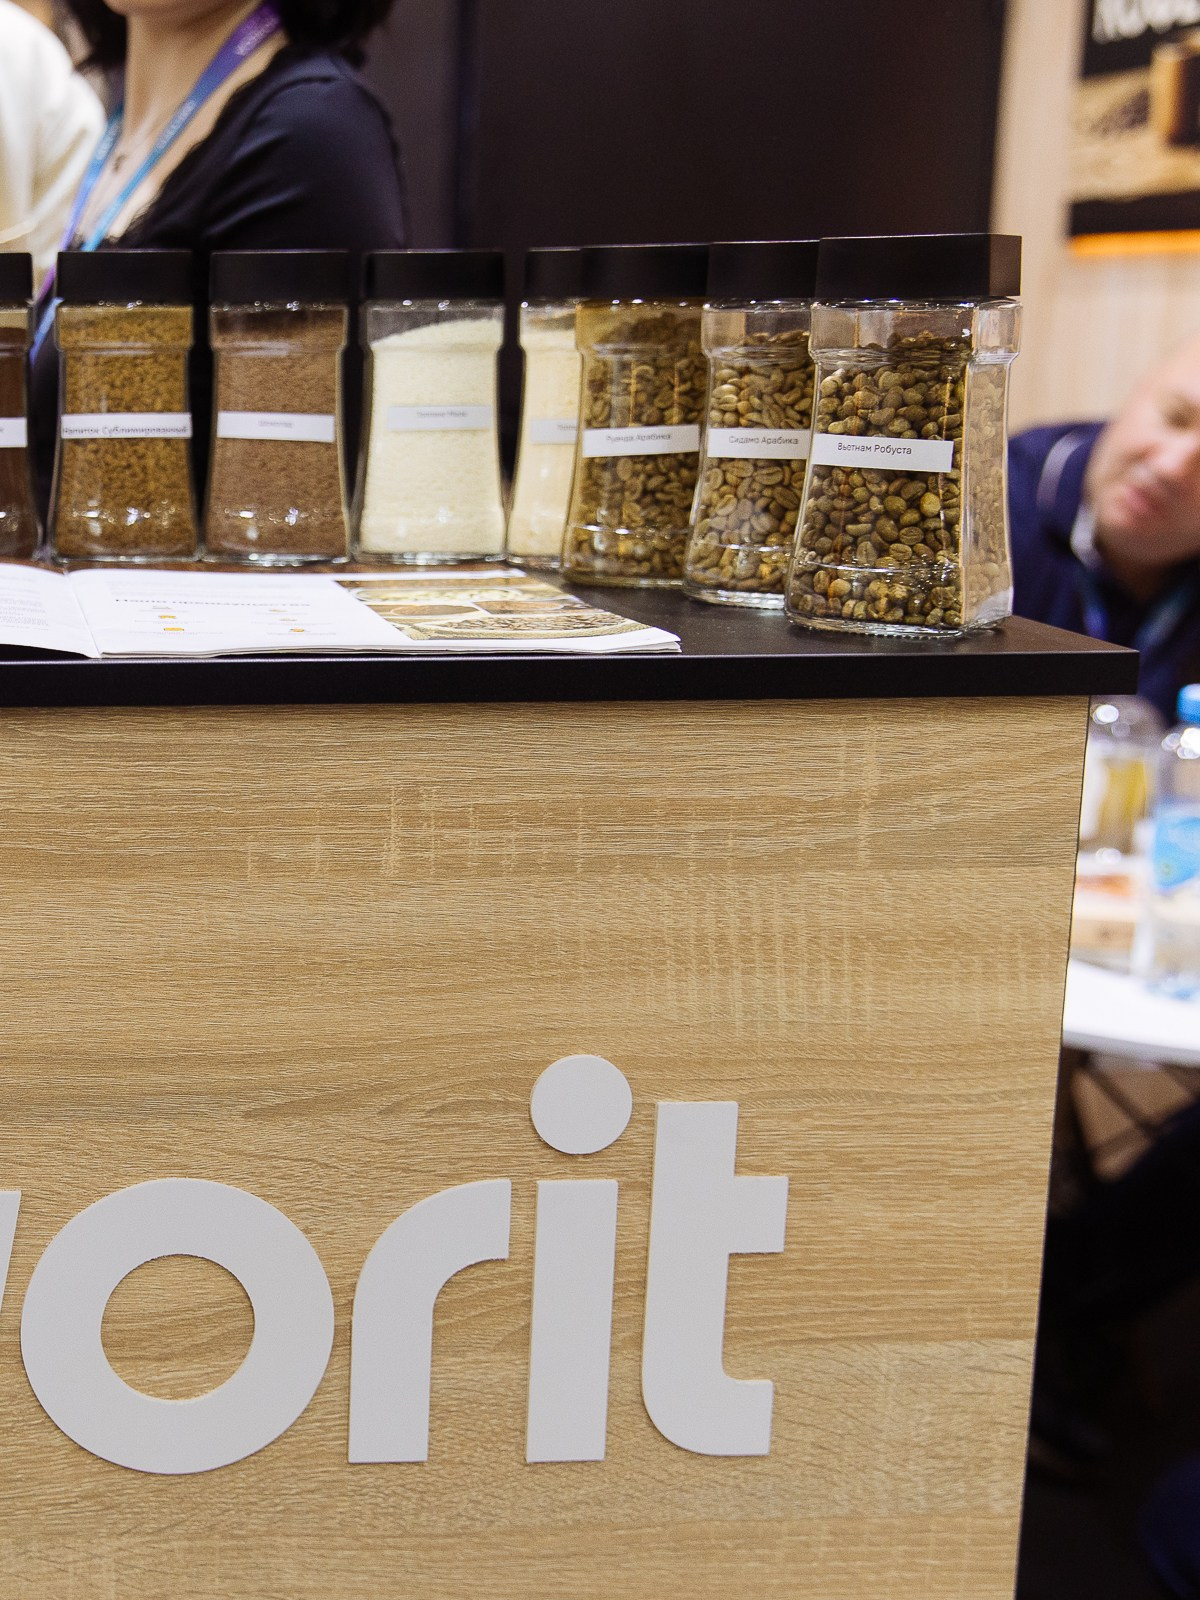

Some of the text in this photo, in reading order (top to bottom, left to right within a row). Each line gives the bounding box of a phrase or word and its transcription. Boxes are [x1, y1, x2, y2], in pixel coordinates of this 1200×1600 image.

[761, 436, 799, 445] Арабика
[837, 442, 912, 455] Вьетнам Робуста
